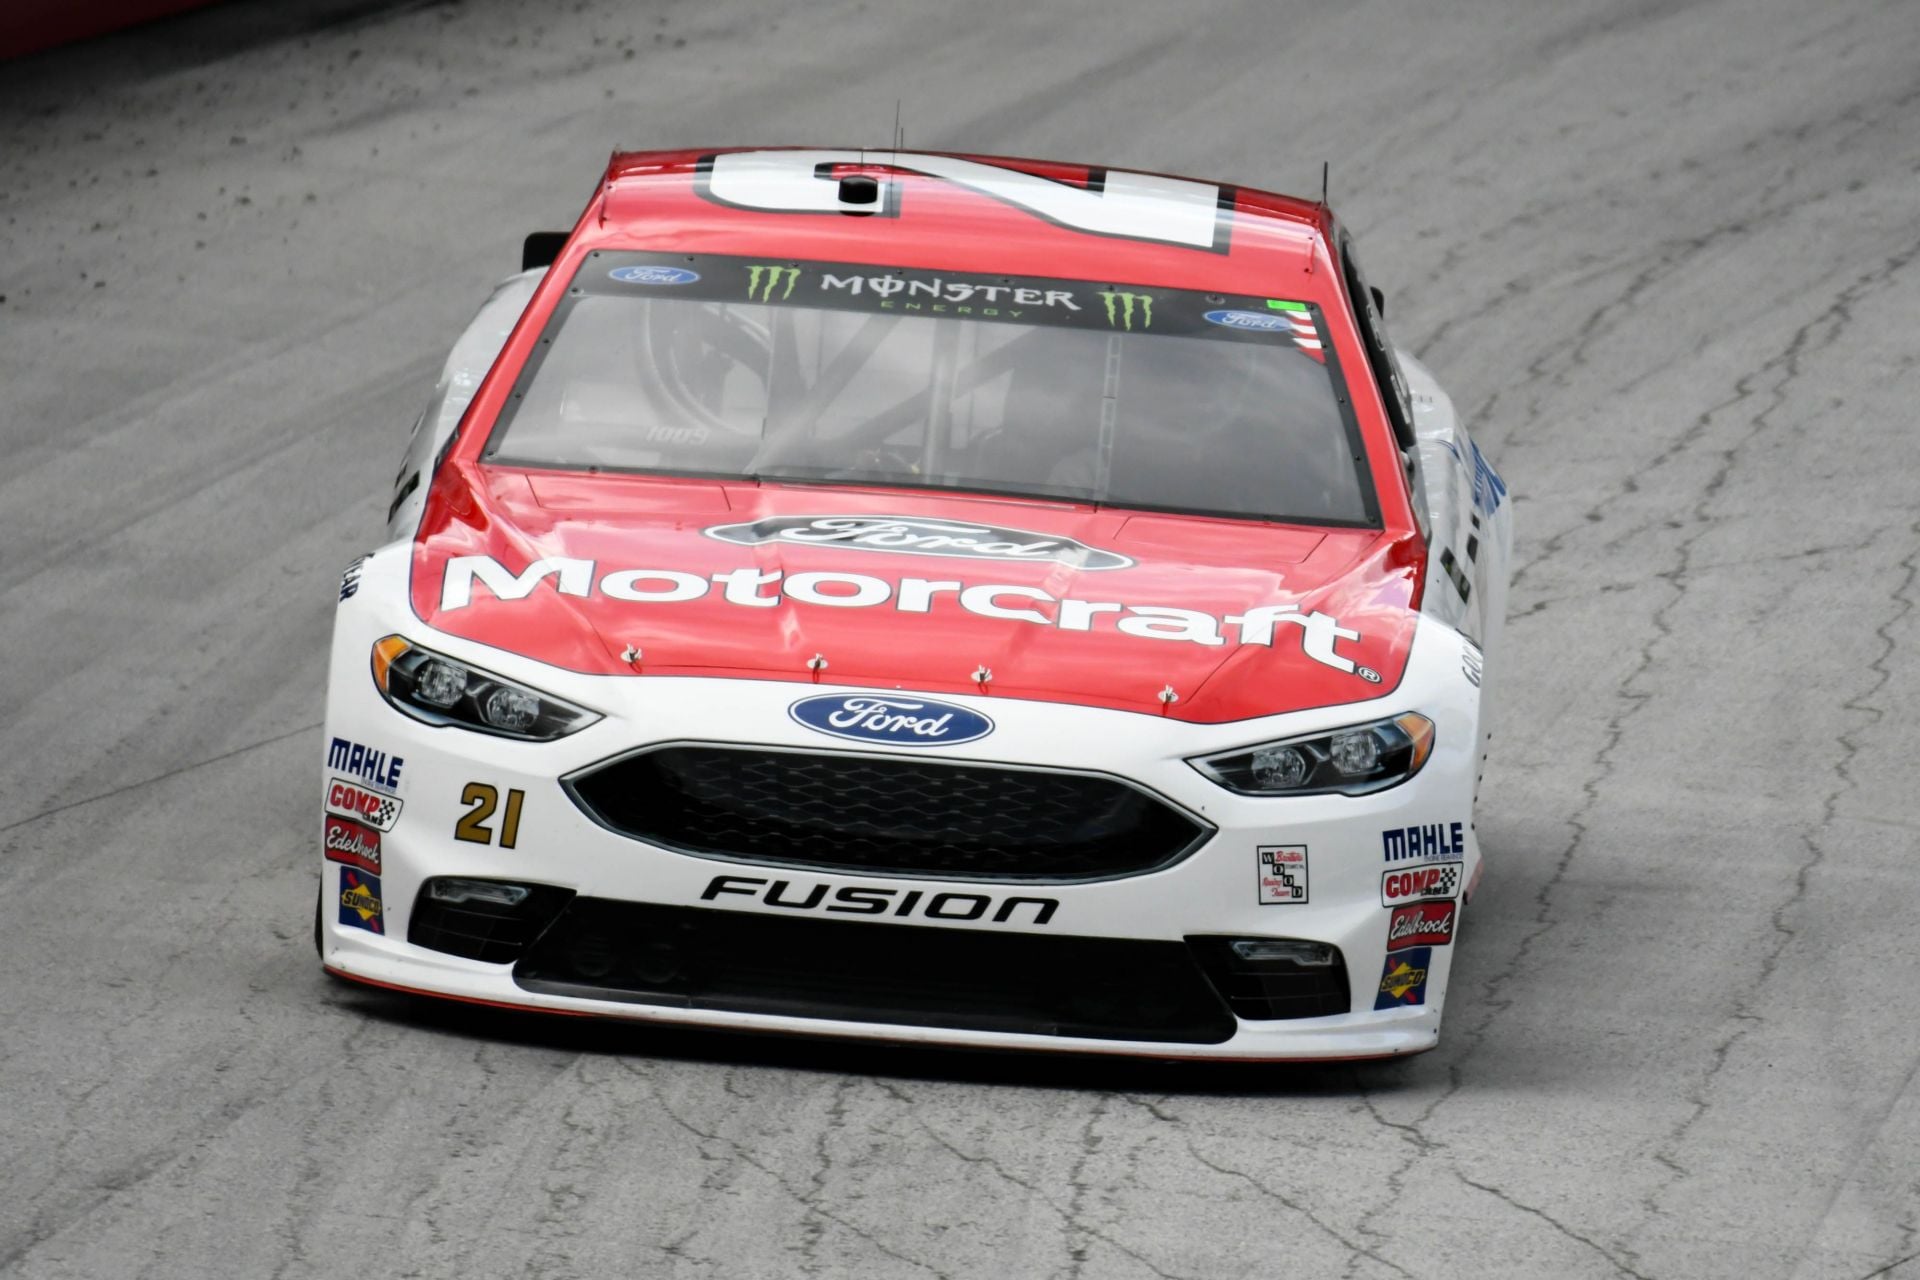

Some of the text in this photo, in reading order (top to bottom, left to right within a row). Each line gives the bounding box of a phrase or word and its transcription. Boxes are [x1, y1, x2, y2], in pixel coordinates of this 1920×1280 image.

[624, 267, 683, 283] Ford
[820, 273, 1082, 312] MONSTER
[880, 300, 1023, 318] ENERGY
[1221, 312, 1278, 329] Ford
[780, 517, 1056, 557] Ford
[439, 554, 1361, 675] Motorcraft
[828, 696, 954, 738] Ford
[327, 736, 404, 789] MAHLE
[329, 784, 381, 816] COMP
[454, 781, 525, 850] 21
[1382, 822, 1464, 862] MAHLE
[699, 874, 1061, 925] FUSION
[1385, 868, 1441, 899] COMP
